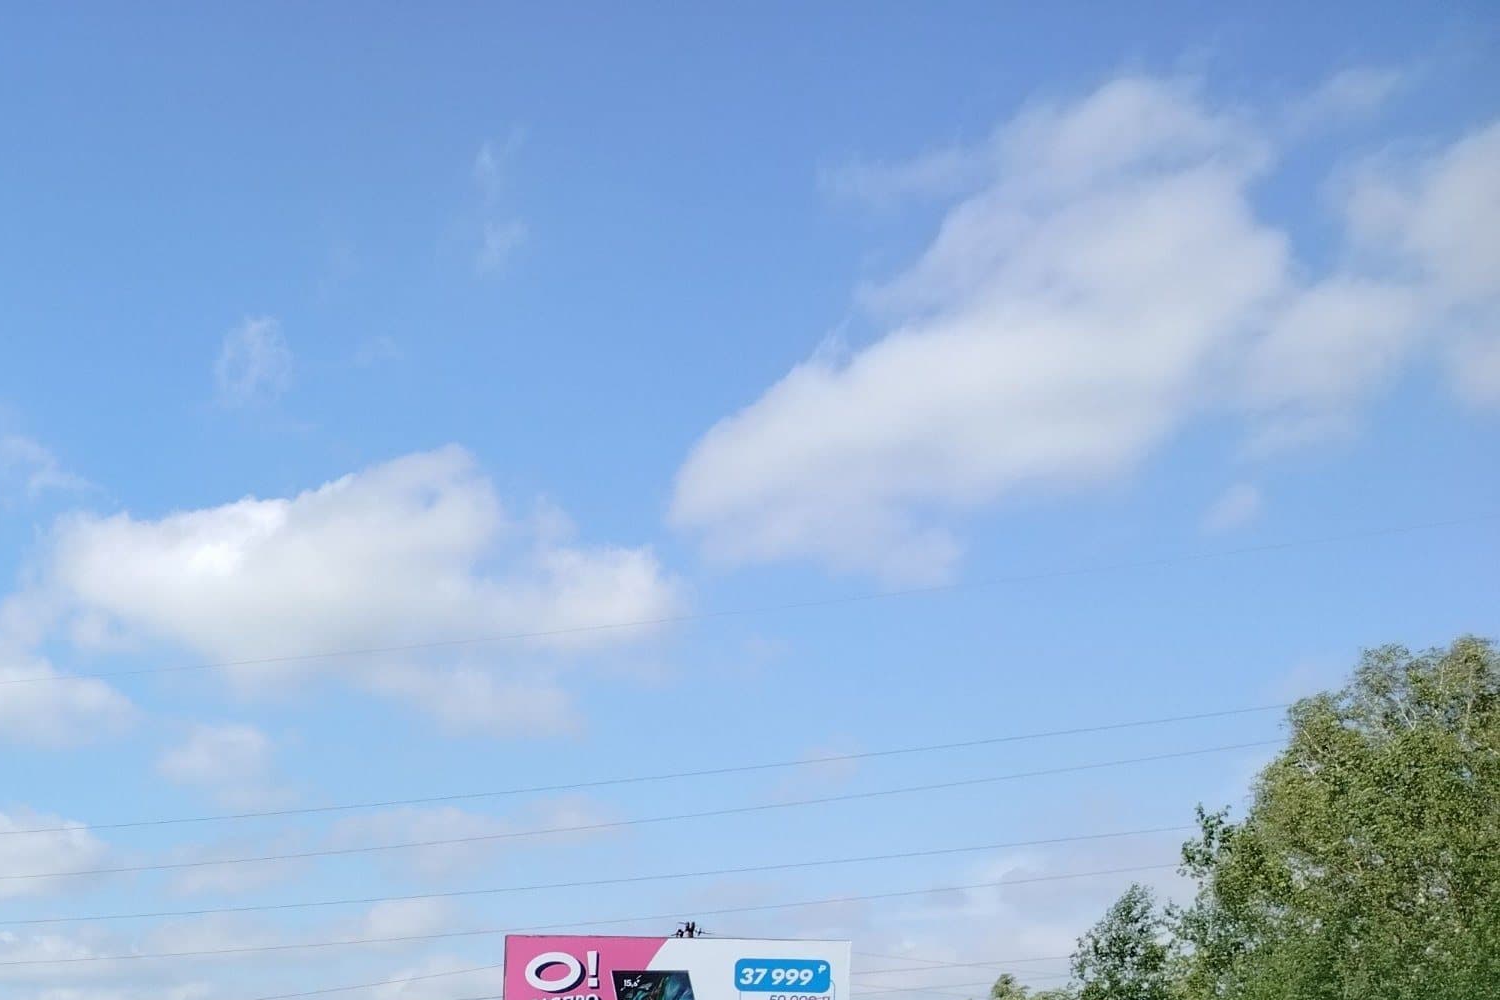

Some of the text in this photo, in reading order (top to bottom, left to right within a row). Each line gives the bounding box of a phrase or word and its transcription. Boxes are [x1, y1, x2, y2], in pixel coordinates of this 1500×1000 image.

[525, 950, 599, 993] О!
[740, 967, 767, 985] 37
[771, 968, 813, 985] 999
